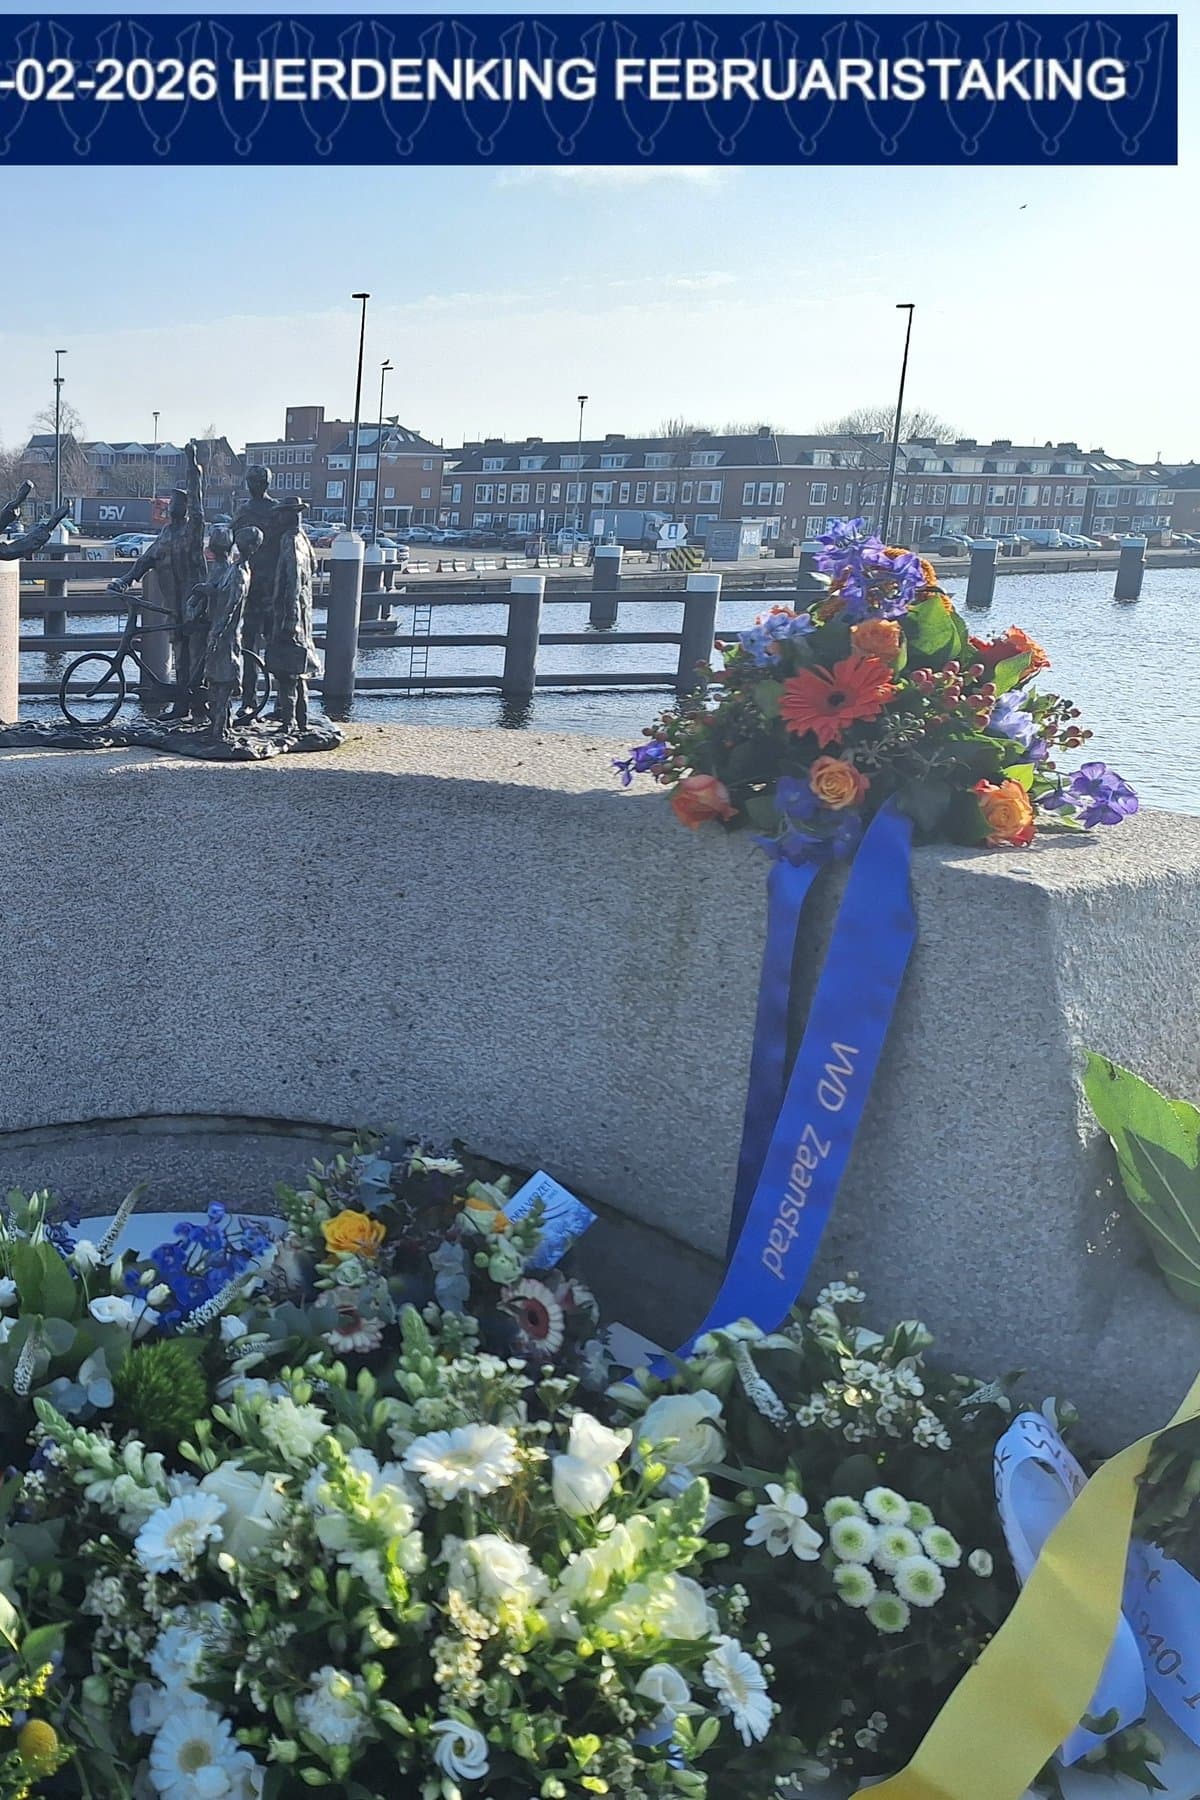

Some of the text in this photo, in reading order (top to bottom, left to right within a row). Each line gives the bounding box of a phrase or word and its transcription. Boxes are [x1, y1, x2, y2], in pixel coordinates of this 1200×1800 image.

[99, 505, 126, 520] DSV
[762, 1042, 860, 1280] VVD Zaanstad
